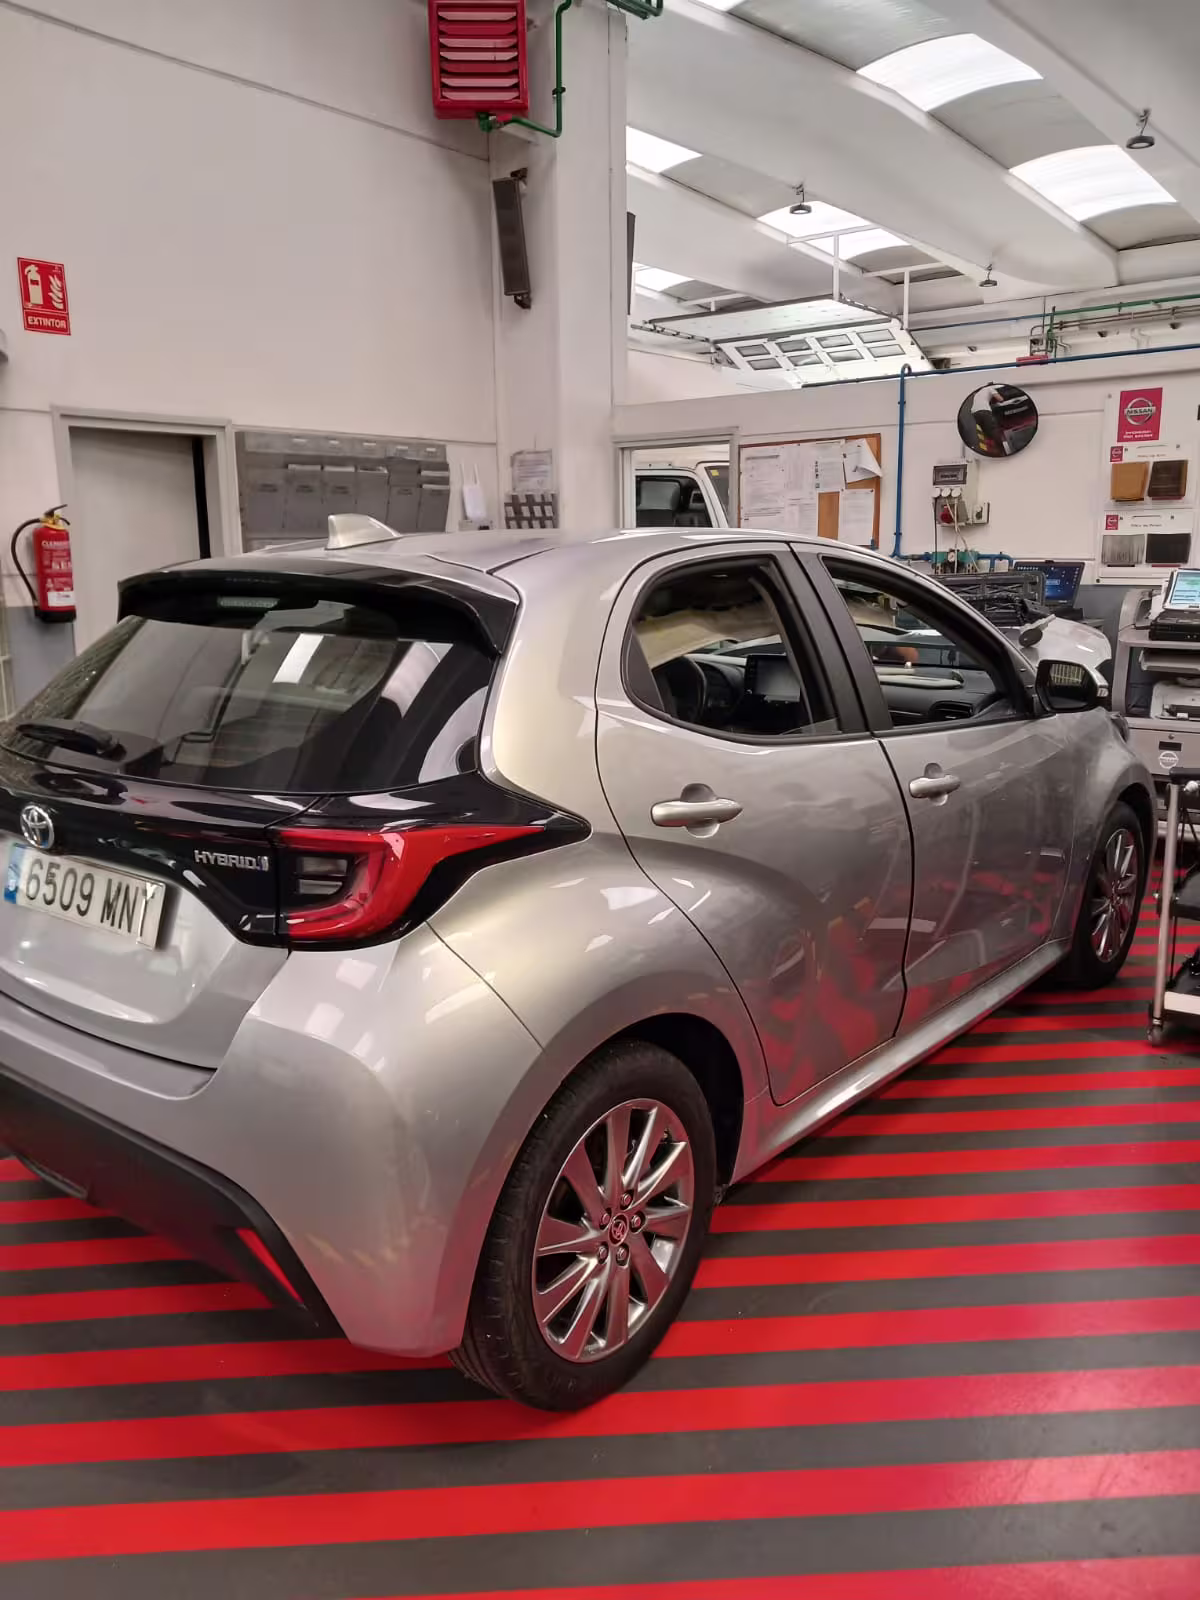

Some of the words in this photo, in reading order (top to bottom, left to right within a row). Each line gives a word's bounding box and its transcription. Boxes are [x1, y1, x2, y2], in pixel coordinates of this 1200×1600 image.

[27, 316, 67, 329] EXTINTOR
[1126, 407, 1153, 415] NISSAN
[194, 849, 257, 870] HYBRID
[25, 858, 95, 917] 6509
[100, 878, 157, 938] MNY
